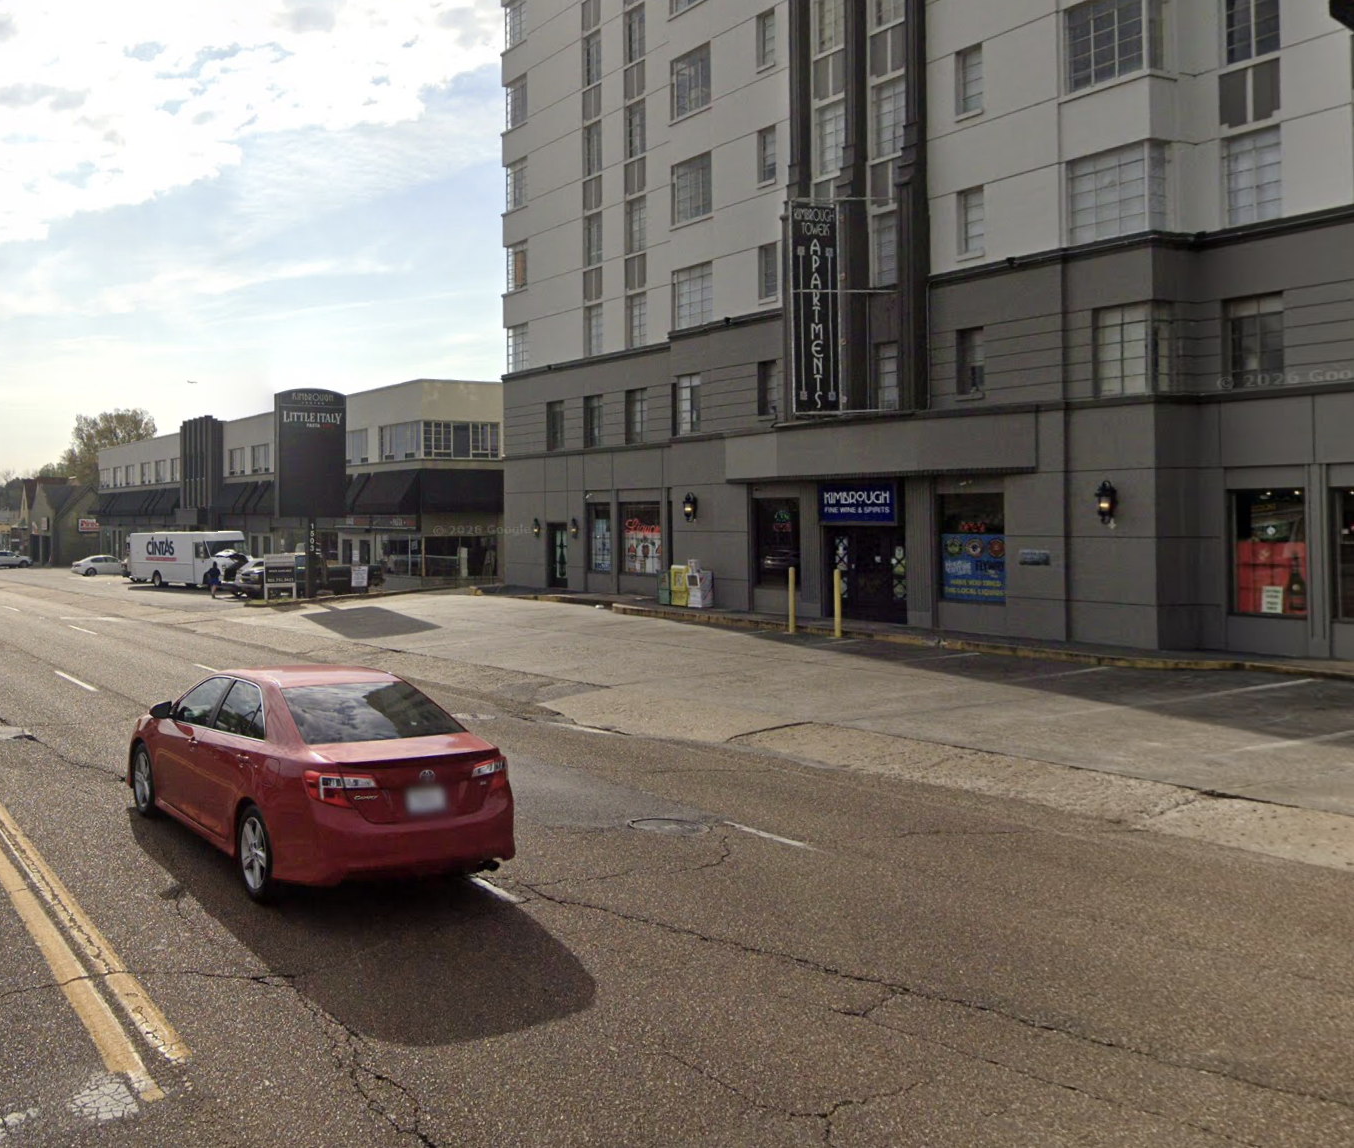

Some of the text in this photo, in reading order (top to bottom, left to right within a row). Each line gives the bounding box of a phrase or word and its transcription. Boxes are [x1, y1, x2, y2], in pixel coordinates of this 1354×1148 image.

[794, 208, 835, 222] KIMBROUGH
[801, 222, 830, 236] TOWERS
[810, 238, 823, 409] APARTMENTS
[283, 410, 342, 425] LITTLE ITALY
[823, 490, 890, 505] KIMBROUGH
[824, 506, 890, 514] FINE WINE & SPIRITS
